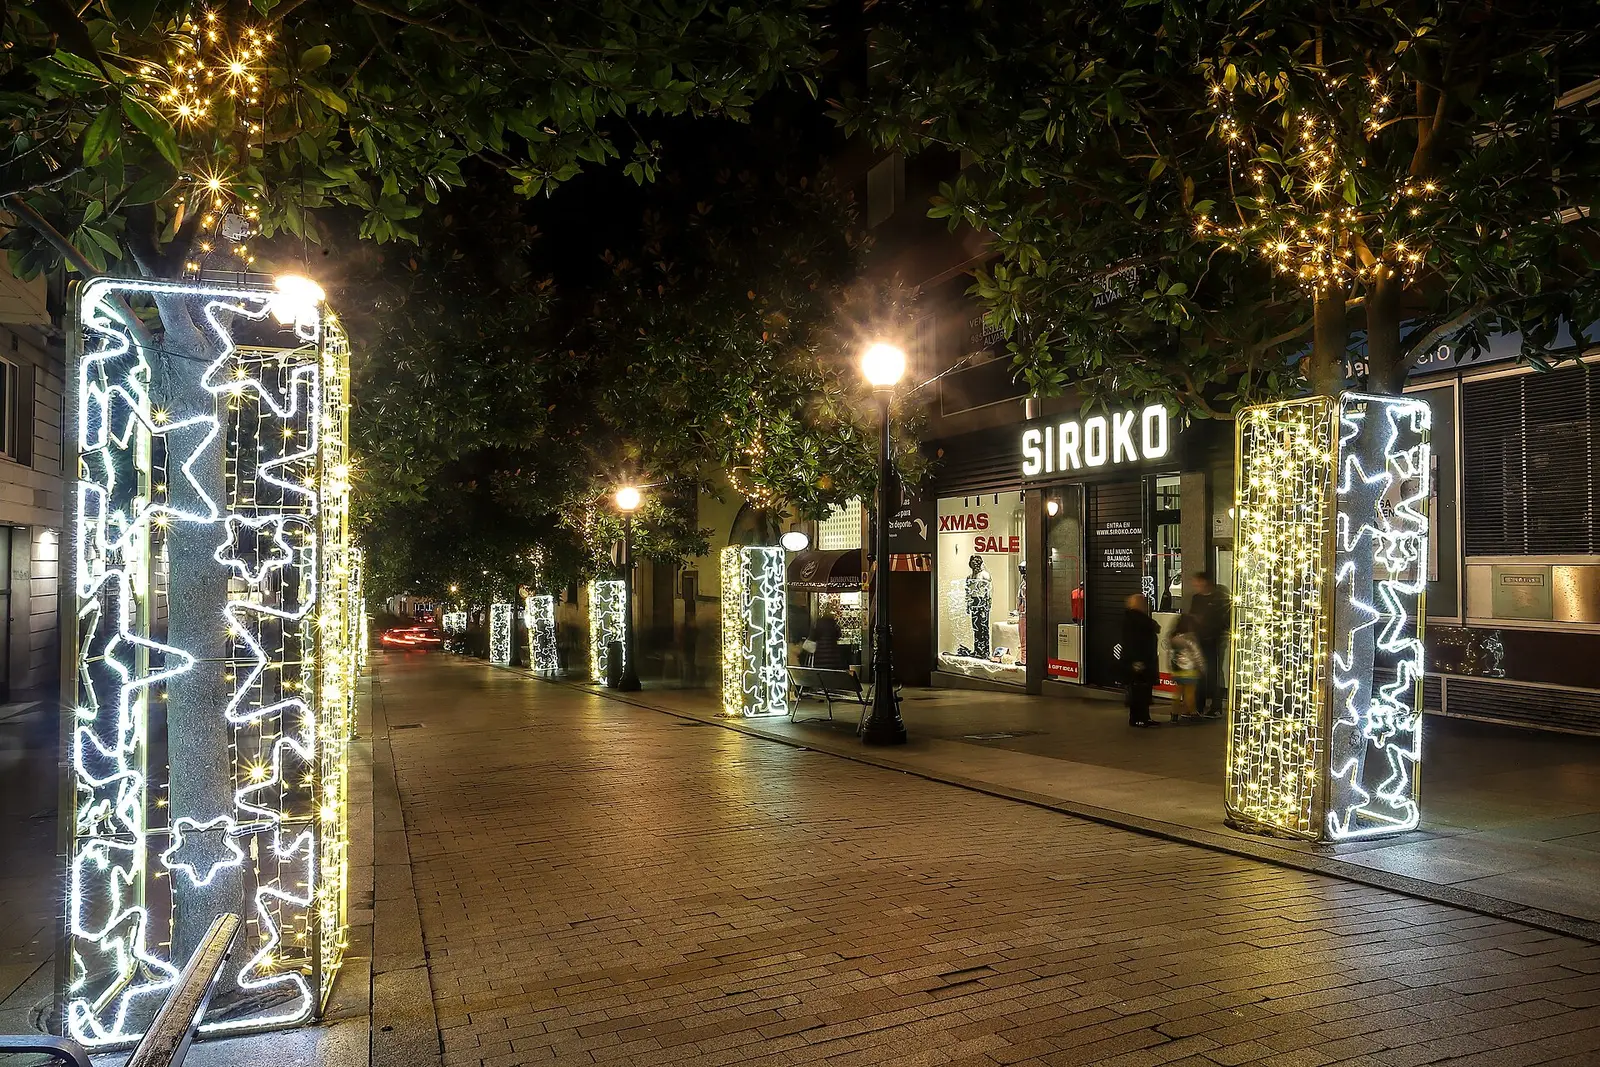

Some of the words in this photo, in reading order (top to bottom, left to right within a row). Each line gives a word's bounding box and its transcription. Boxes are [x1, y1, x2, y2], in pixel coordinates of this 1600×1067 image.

[1022, 403, 1170, 476] SIROKO
[939, 512, 989, 532] XMAS
[1096, 528, 1142, 536] WWW.SIROKO.COM
[974, 535, 1020, 553] SALE
